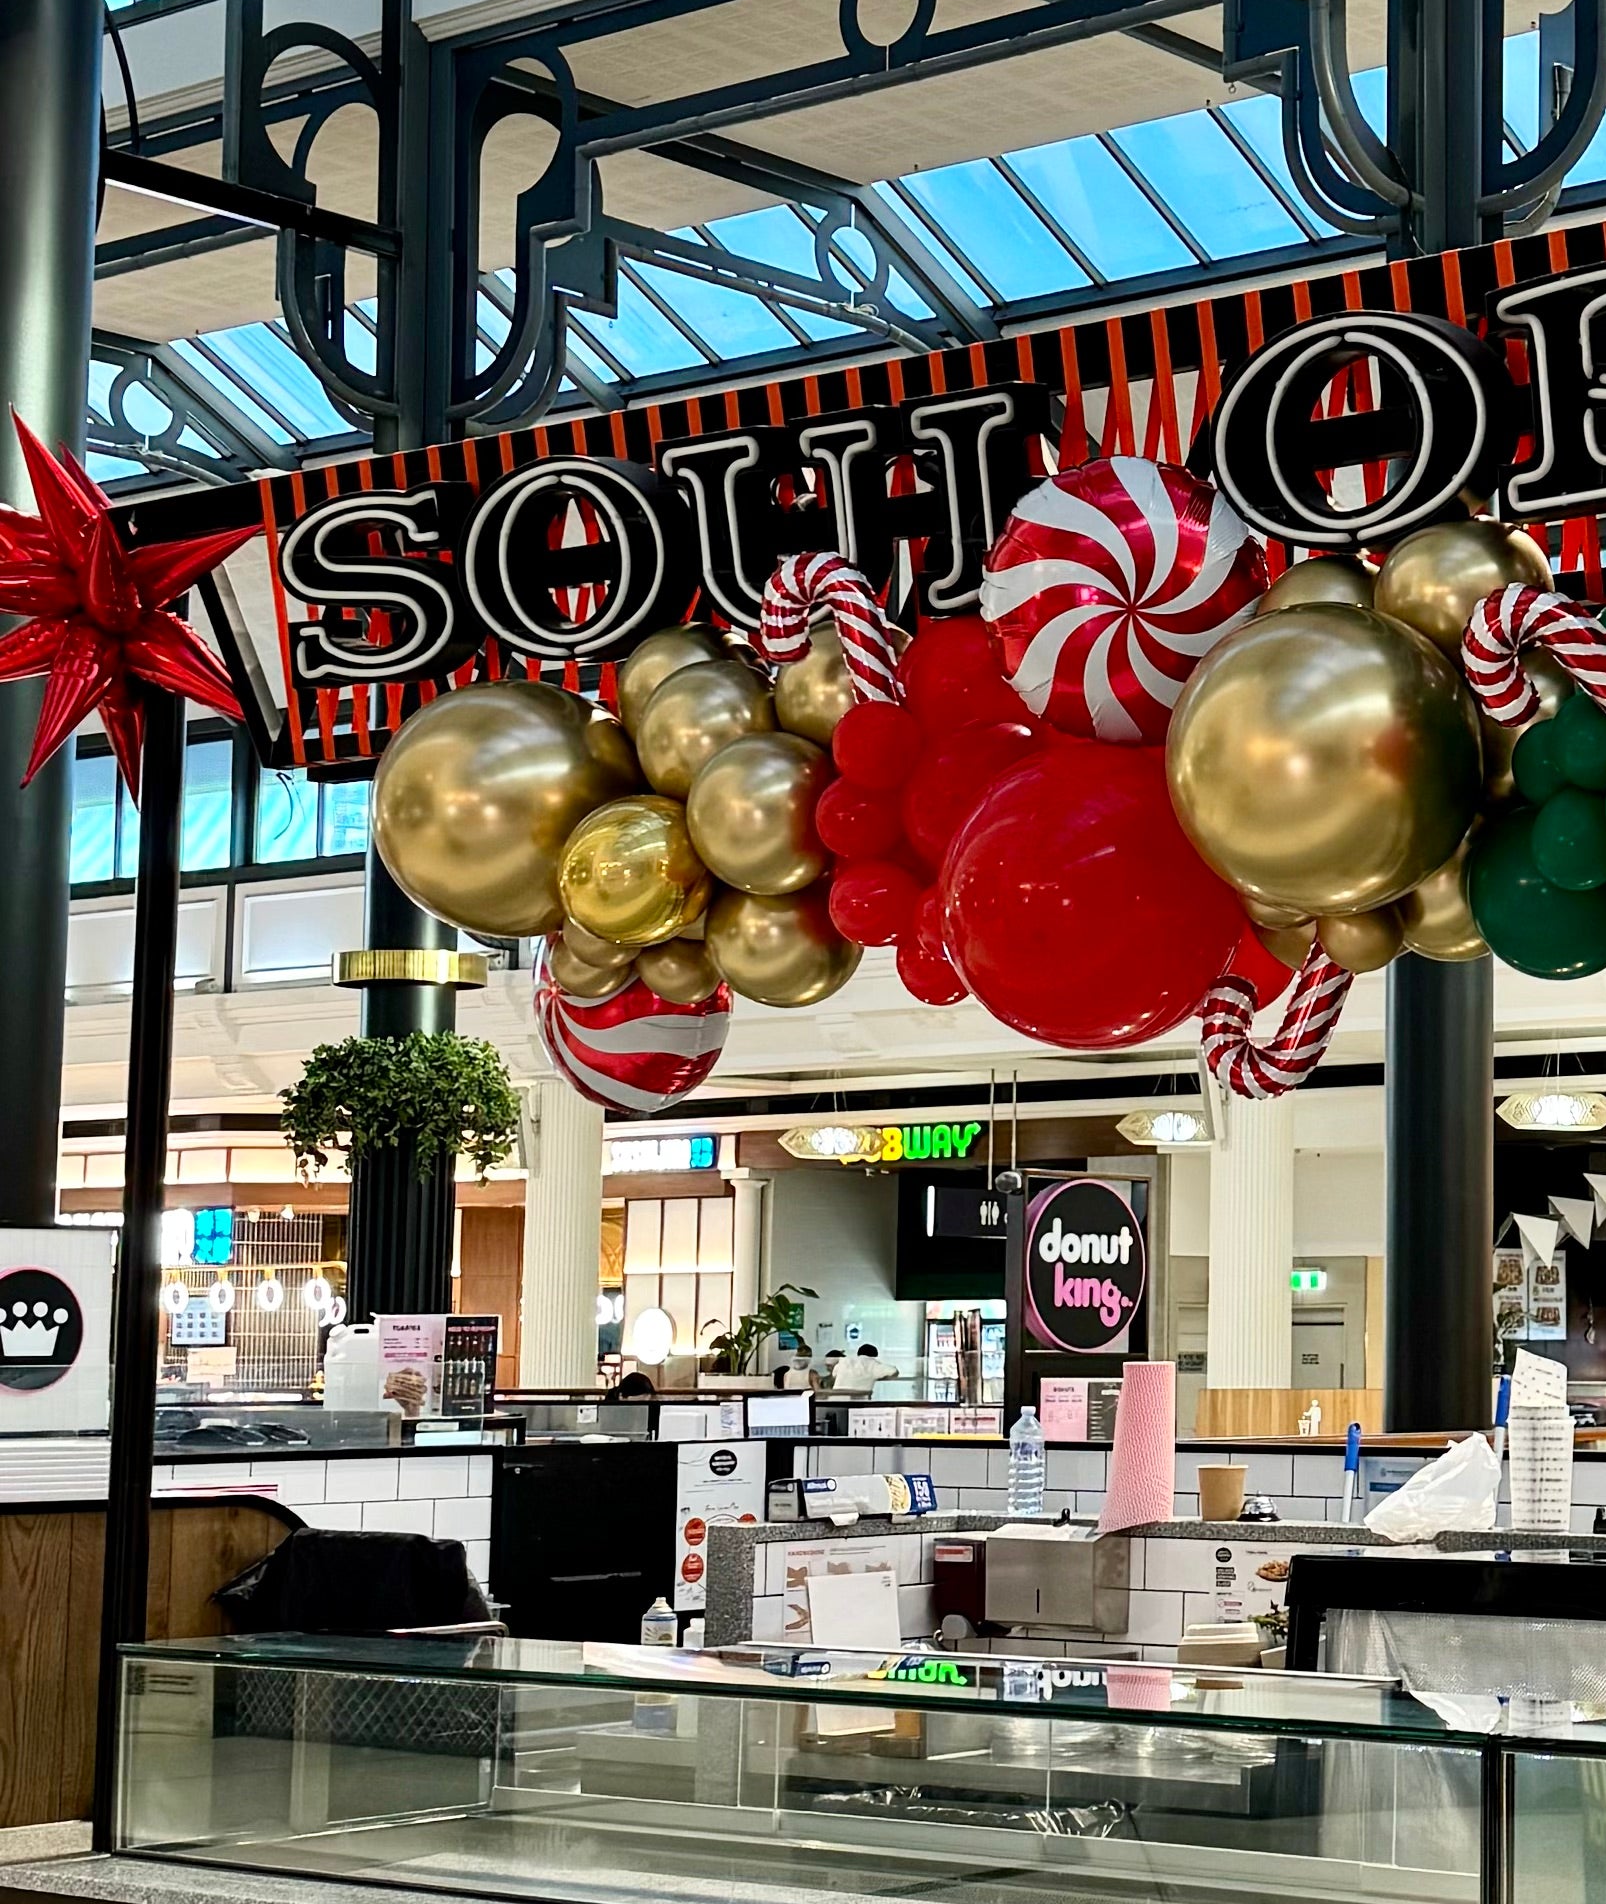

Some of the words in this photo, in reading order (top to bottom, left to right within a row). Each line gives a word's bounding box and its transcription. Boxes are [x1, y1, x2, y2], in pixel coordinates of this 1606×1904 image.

[838, 1122, 982, 1165] BWAY
[1039, 1217, 1133, 1264] donut
[1054, 1261, 1123, 1327] king
